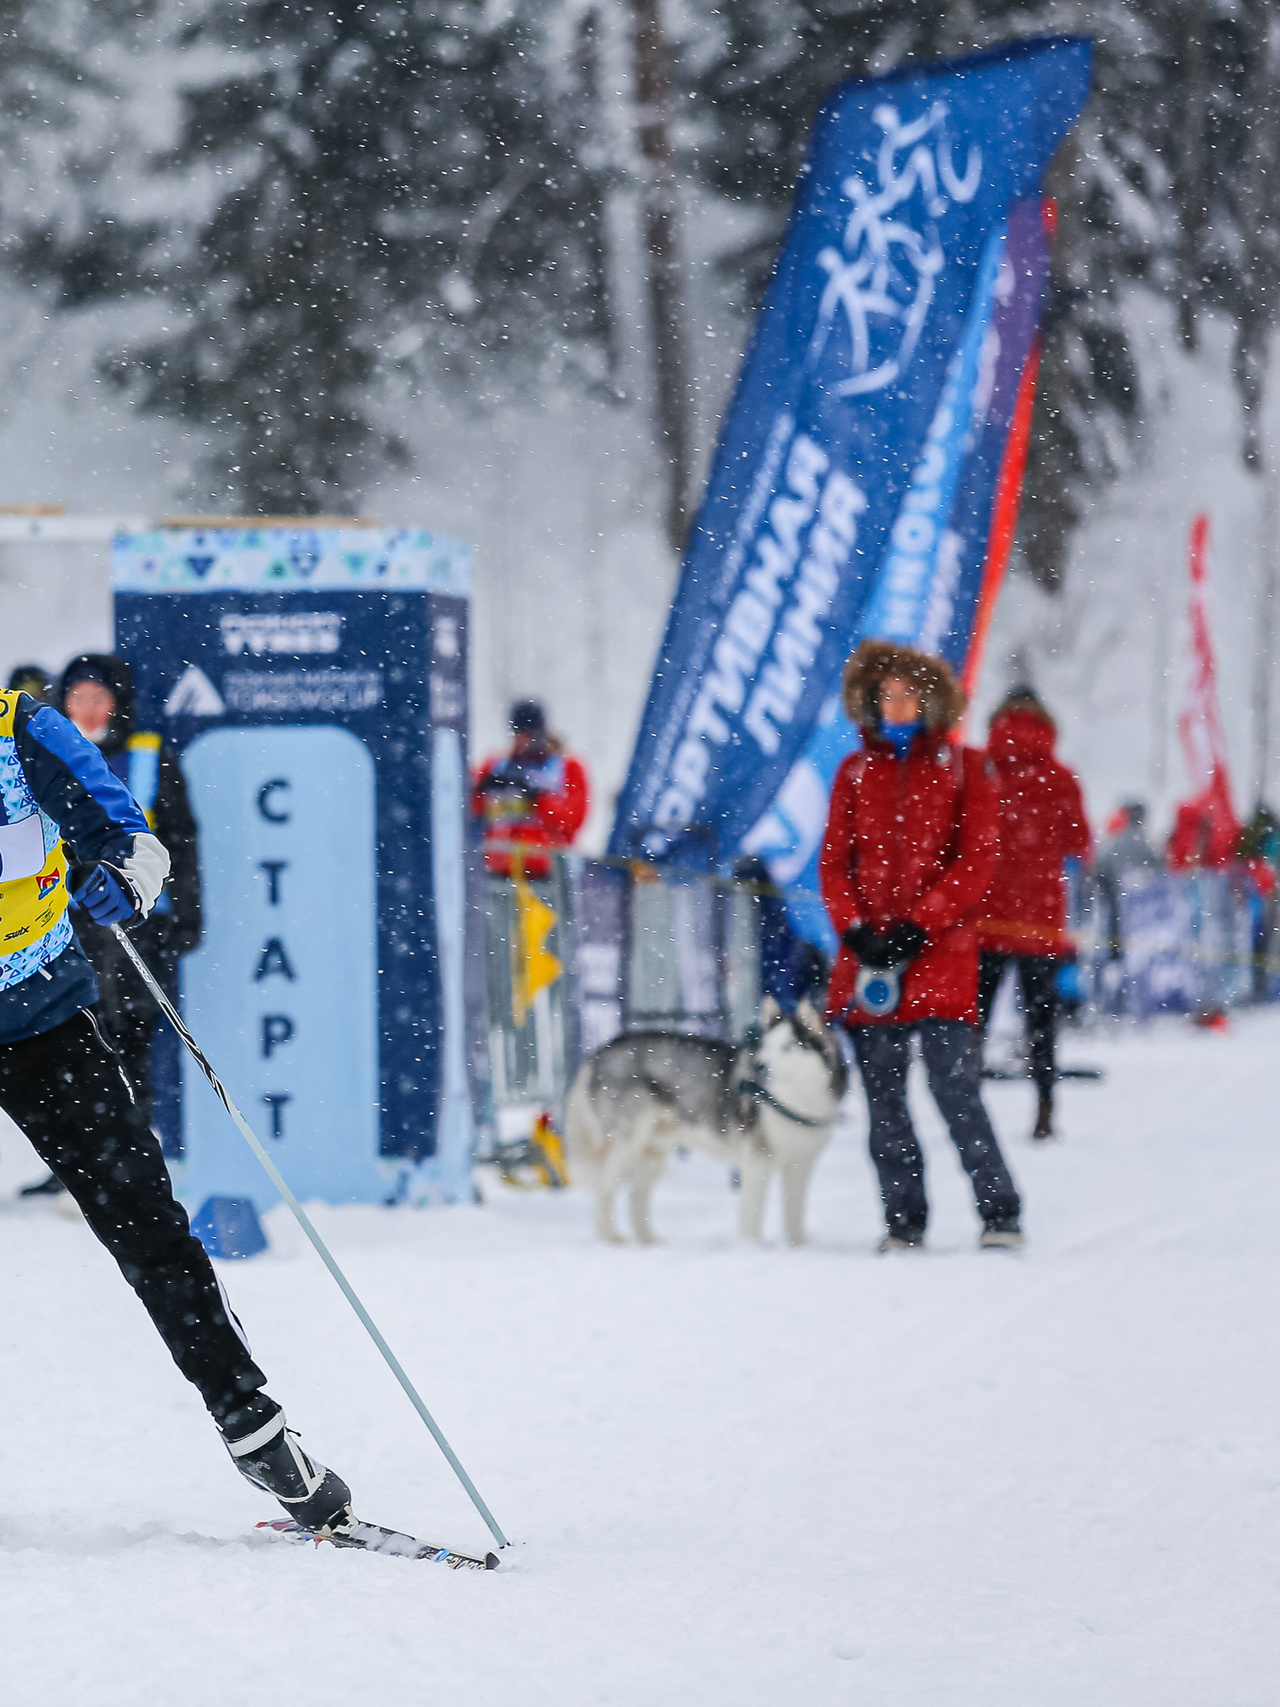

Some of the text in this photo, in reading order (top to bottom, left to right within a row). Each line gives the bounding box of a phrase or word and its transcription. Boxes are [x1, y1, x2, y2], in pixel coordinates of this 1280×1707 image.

[652, 432, 829, 832] ОРТИВНАЯ
[744, 470, 867, 756] ЛИНИЯ
[254, 778, 299, 1140] СТАРТ
